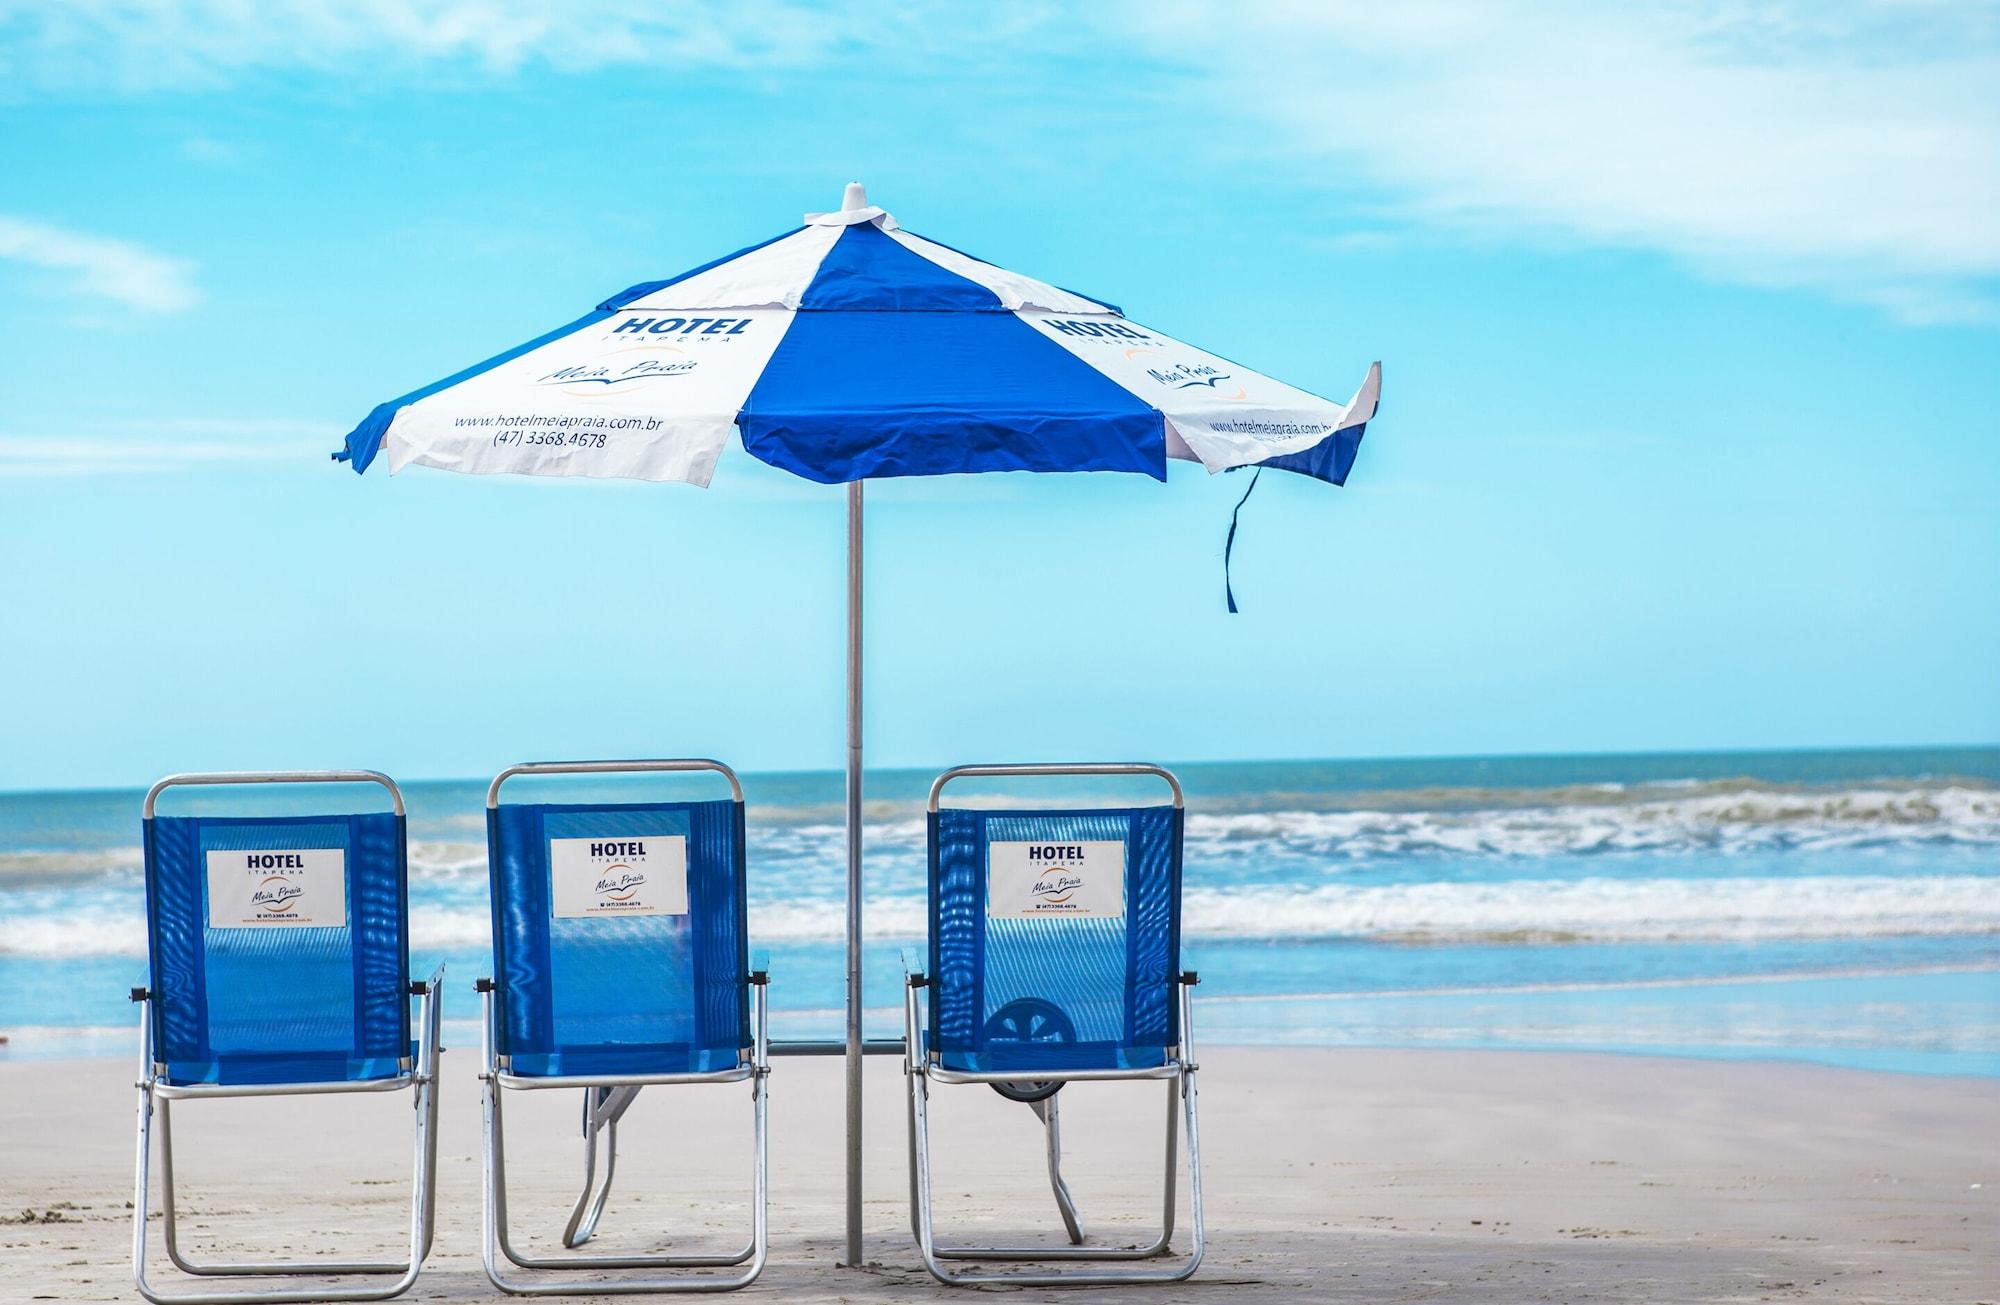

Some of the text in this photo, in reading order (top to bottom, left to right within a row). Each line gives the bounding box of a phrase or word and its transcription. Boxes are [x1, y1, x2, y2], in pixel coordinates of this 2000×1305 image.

[612, 318, 753, 335] HOTEL
[1041, 319, 1151, 339] HOTEL
[601, 335, 731, 343] ITAPEMA
[536, 360, 698, 382] Meia Praia
[1146, 368, 1187, 386] Meia
[455, 414, 663, 432] www.hotelmeiapraia.com.br
[493, 430, 607, 448] (47) 3368.4678
[590, 842, 646, 857] HOTEL
[1029, 846, 1085, 860] HOTEL
[247, 854, 304, 868] HOTEL
[595, 873, 644, 892] Meia Praia
[1032, 876, 1081, 894] Meia Praia
[252, 886, 302, 903] Meia Praia
